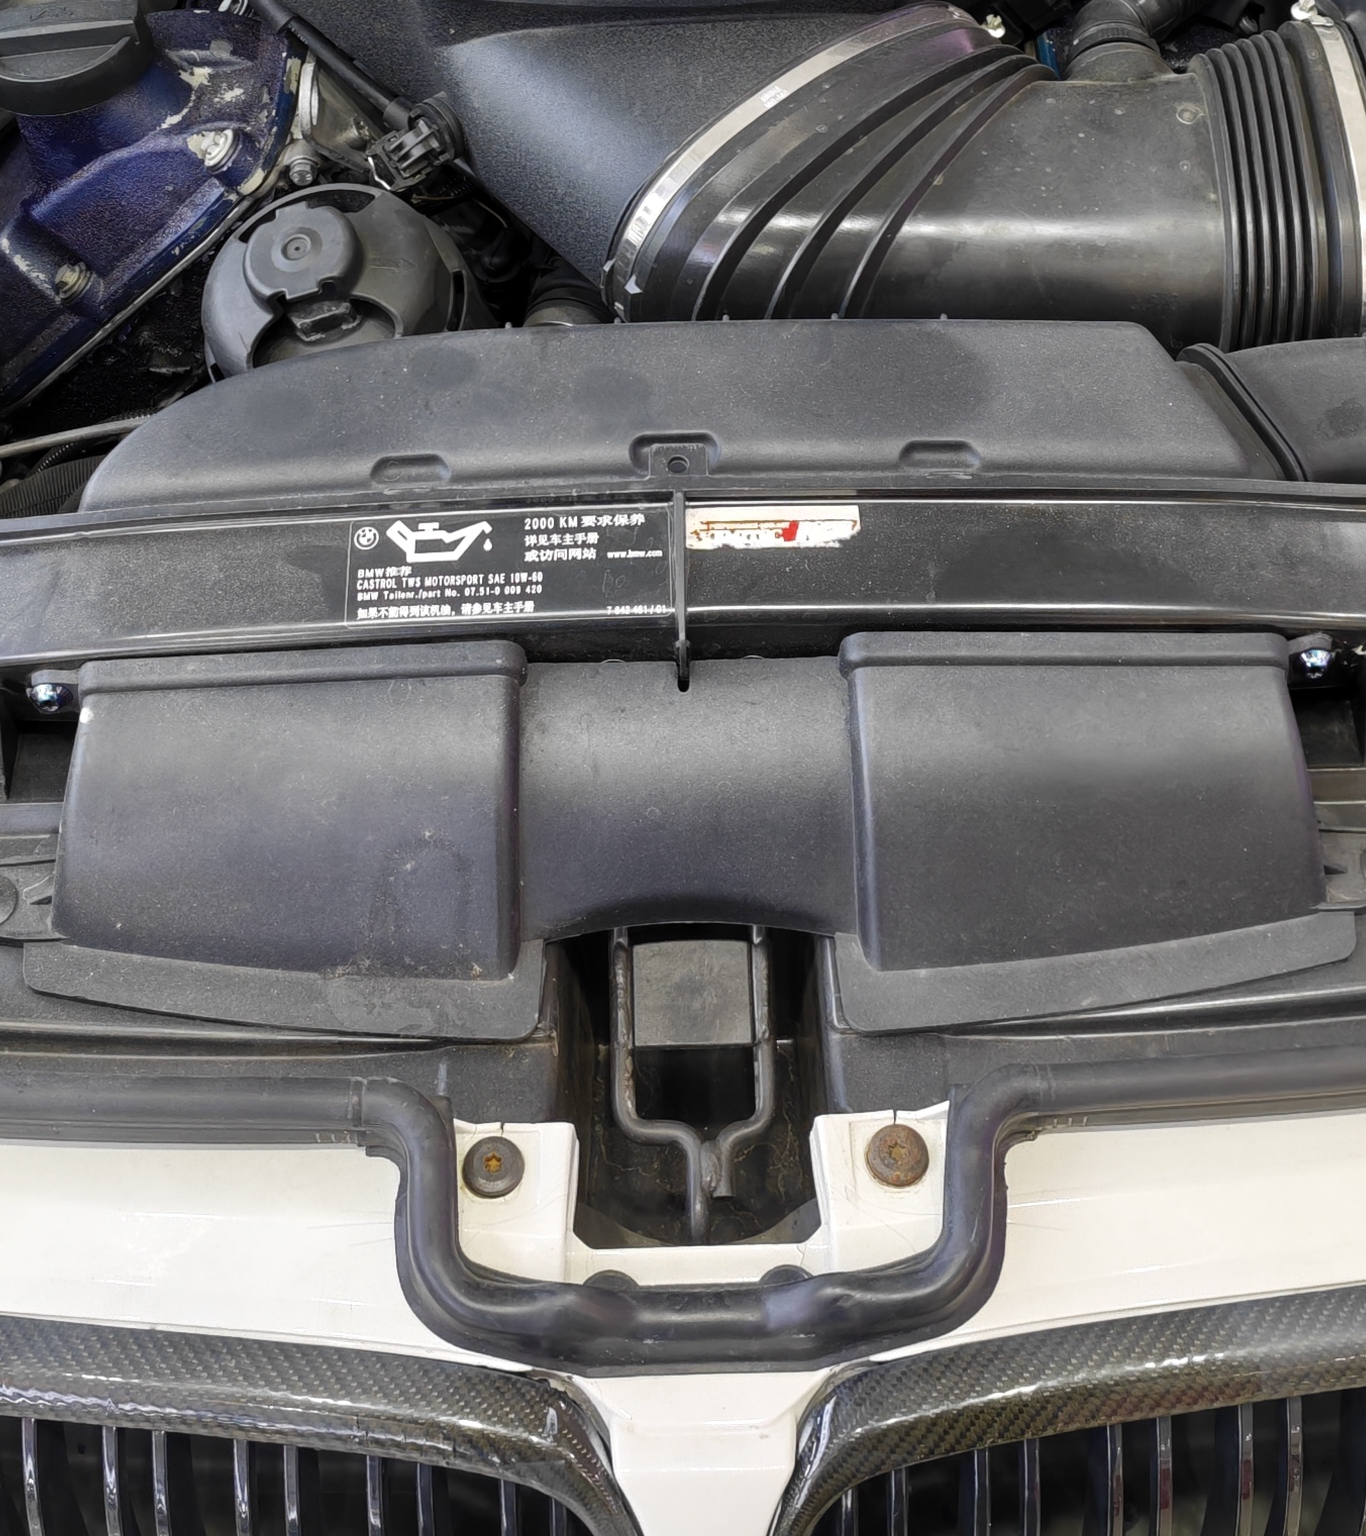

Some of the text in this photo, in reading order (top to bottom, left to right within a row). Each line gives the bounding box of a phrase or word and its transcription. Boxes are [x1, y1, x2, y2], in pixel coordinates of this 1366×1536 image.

[524, 513, 646, 531] 2000 KM 要求保养
[524, 531, 600, 547] 详见车主手册
[524, 547, 597, 563] 或访问网站
[356, 571, 544, 591] CASTROL TWS MOTORSPORT SAE 10W-60
[357, 591, 379, 602] BMW
[525, 584, 543, 595] 420
